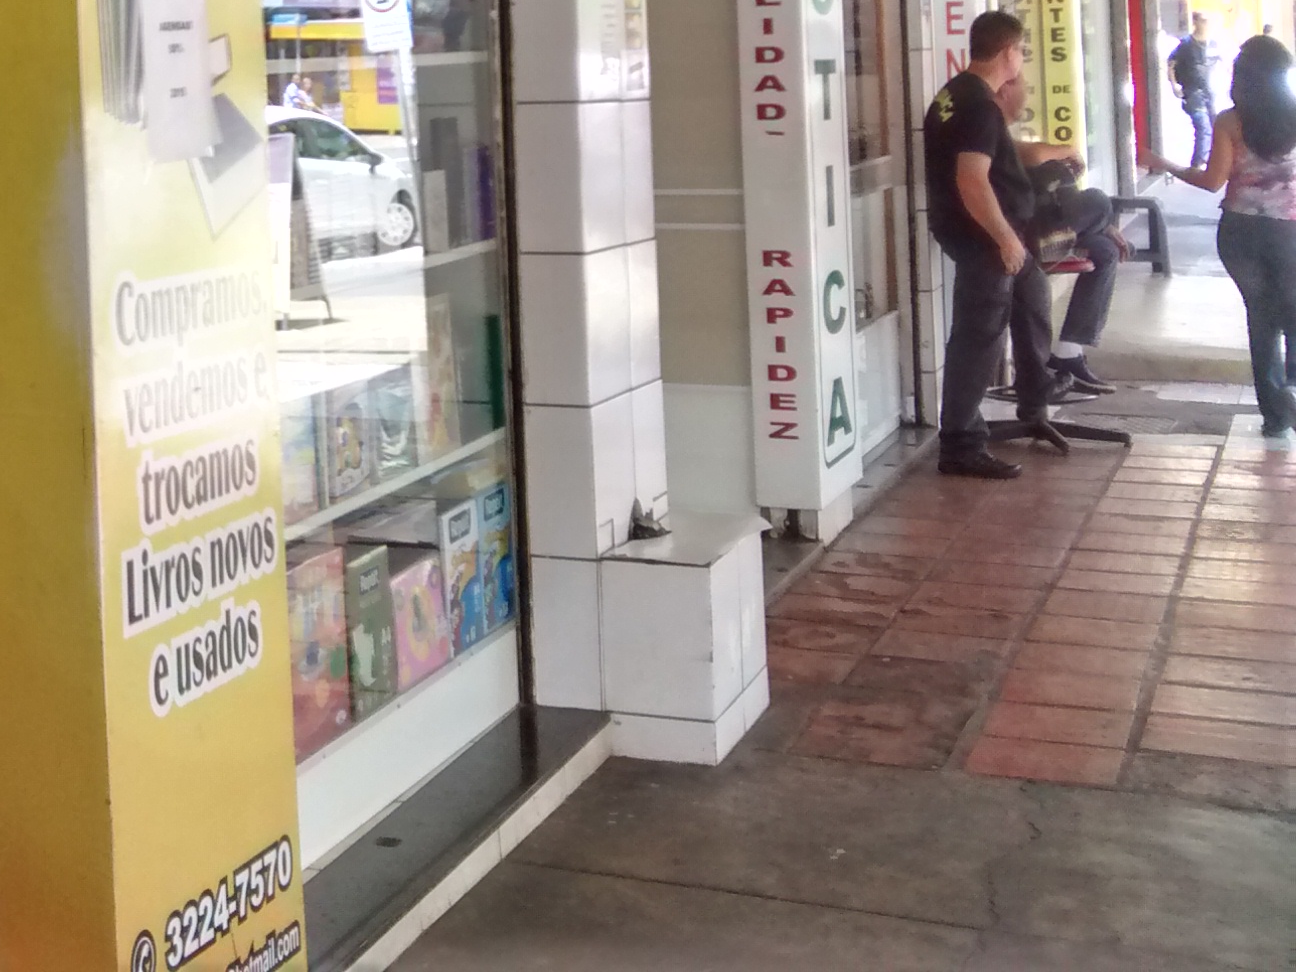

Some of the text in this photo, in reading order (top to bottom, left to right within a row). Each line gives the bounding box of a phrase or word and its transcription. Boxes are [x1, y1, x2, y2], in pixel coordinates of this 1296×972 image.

[1052, 84, 1072, 95] DE
[123, 351, 270, 437] vendemos e
[761, 249, 800, 440] RAPIDEZ
[141, 438, 257, 525] trocamos
[126, 515, 276, 626] Livros novos
[153, 607, 260, 707] e usados
[165, 835, 293, 970] 3224-7570
